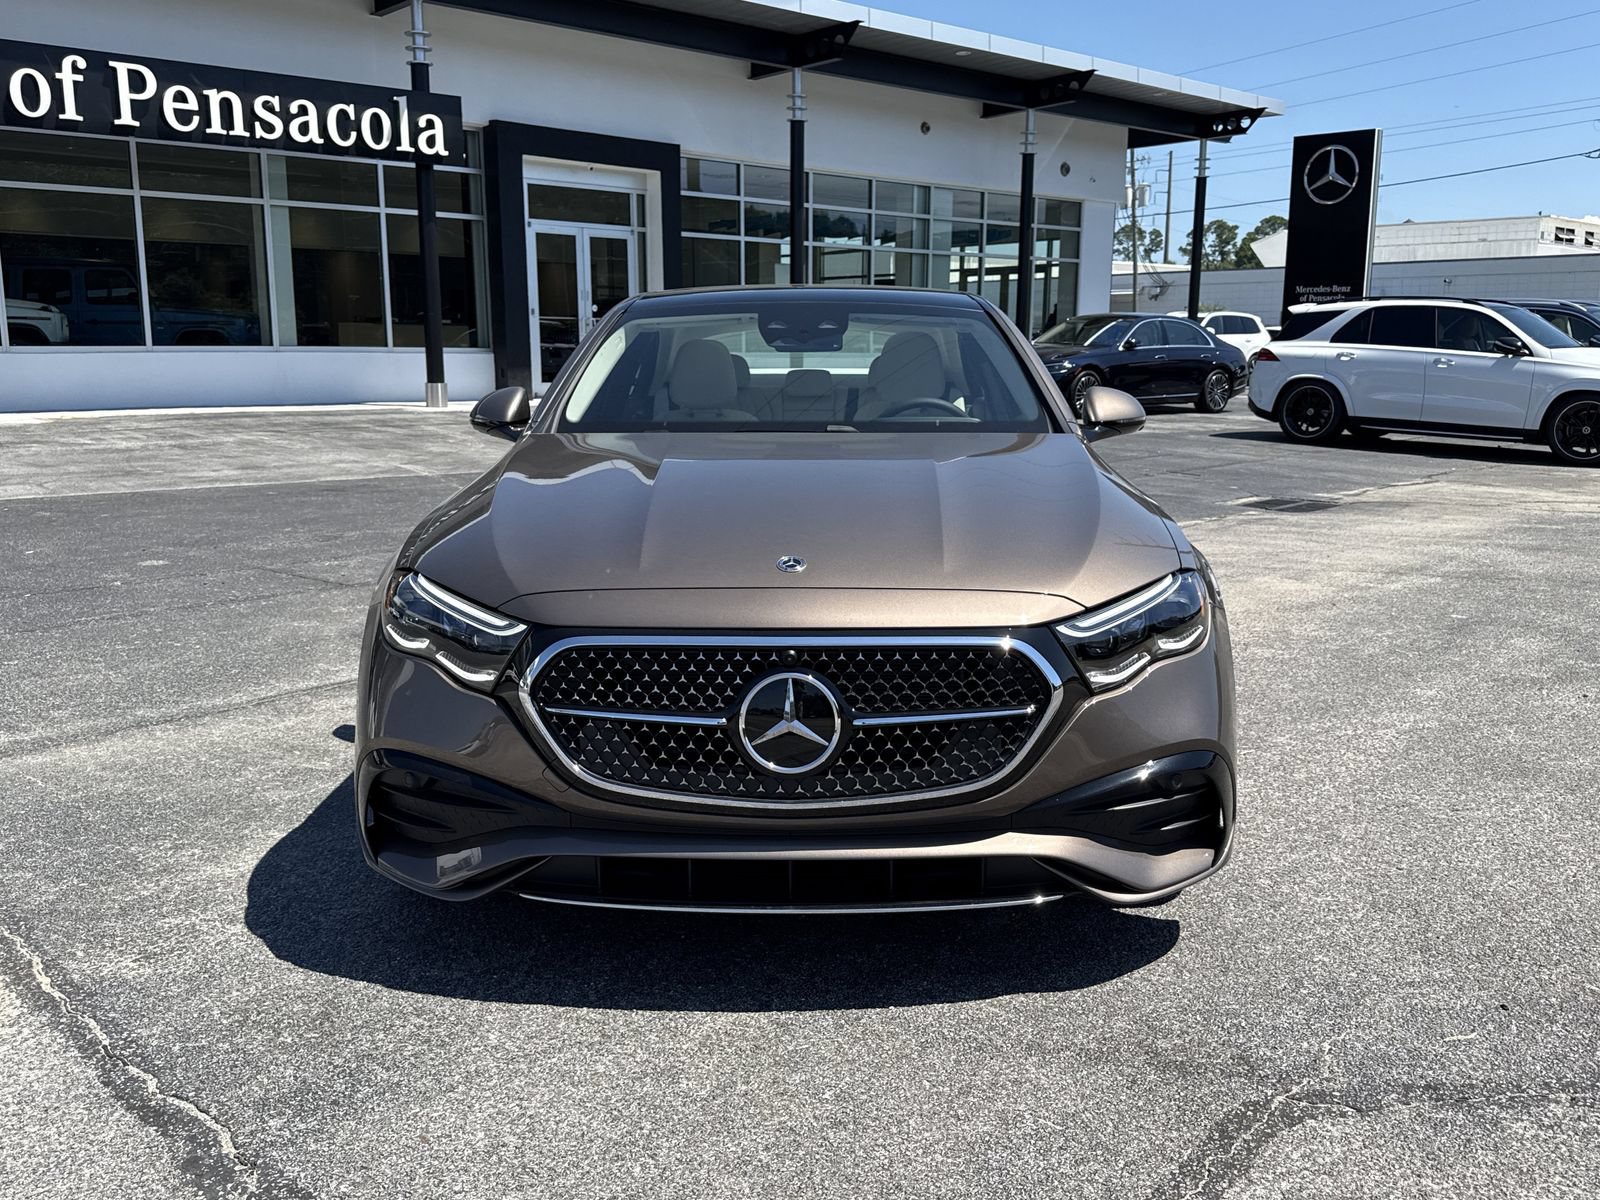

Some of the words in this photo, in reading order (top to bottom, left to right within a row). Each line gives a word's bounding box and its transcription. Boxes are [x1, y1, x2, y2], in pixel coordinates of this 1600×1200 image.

[9, 54, 88, 121] of
[108, 60, 449, 156] Pensacola
[1295, 285, 1351, 294] Mercedes-Benz
[1299, 294, 1307, 302] of
